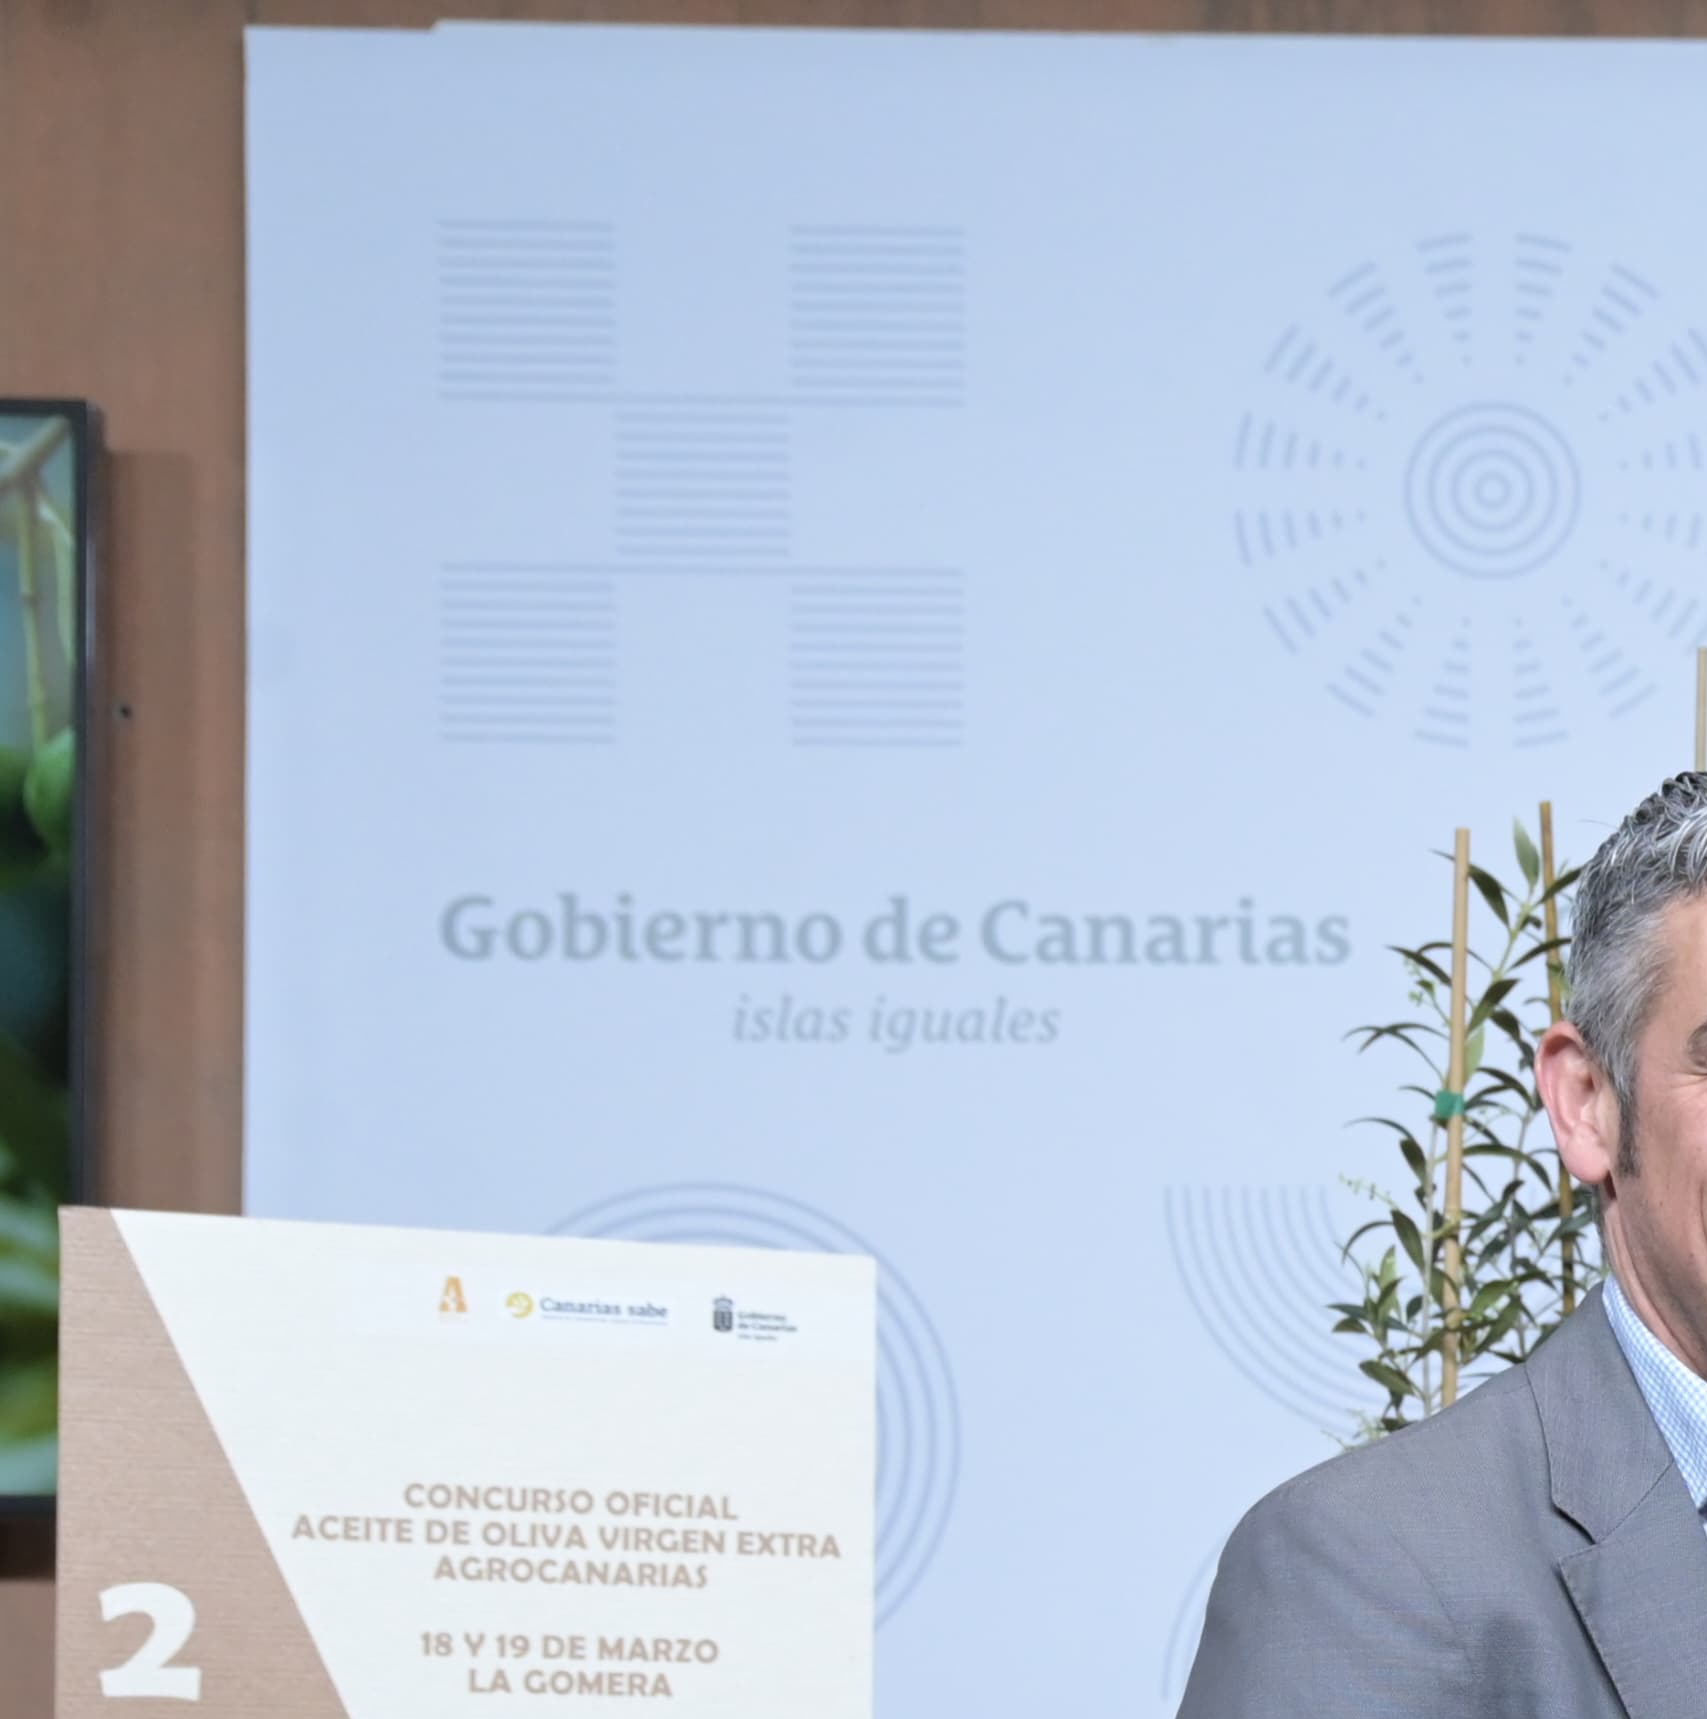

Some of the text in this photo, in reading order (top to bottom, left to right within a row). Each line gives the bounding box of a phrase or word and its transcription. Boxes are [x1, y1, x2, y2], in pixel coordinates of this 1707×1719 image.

[439, 891, 1352, 968] Gobierno de Canarias
[732, 994, 1060, 1054] islas iguales
[540, 1296, 668, 1318] Canarias sabe
[404, 1483, 739, 1521] CONCURSO OFICIAL
[292, 1514, 842, 1560] ACEITE DE OLIVA VIRGEN EXTRA
[433, 1555, 709, 1589] AGROCANARIAS
[421, 1632, 720, 1664] 18 Y 19 DE MARZO
[469, 1669, 673, 1700] LA GOMERA
